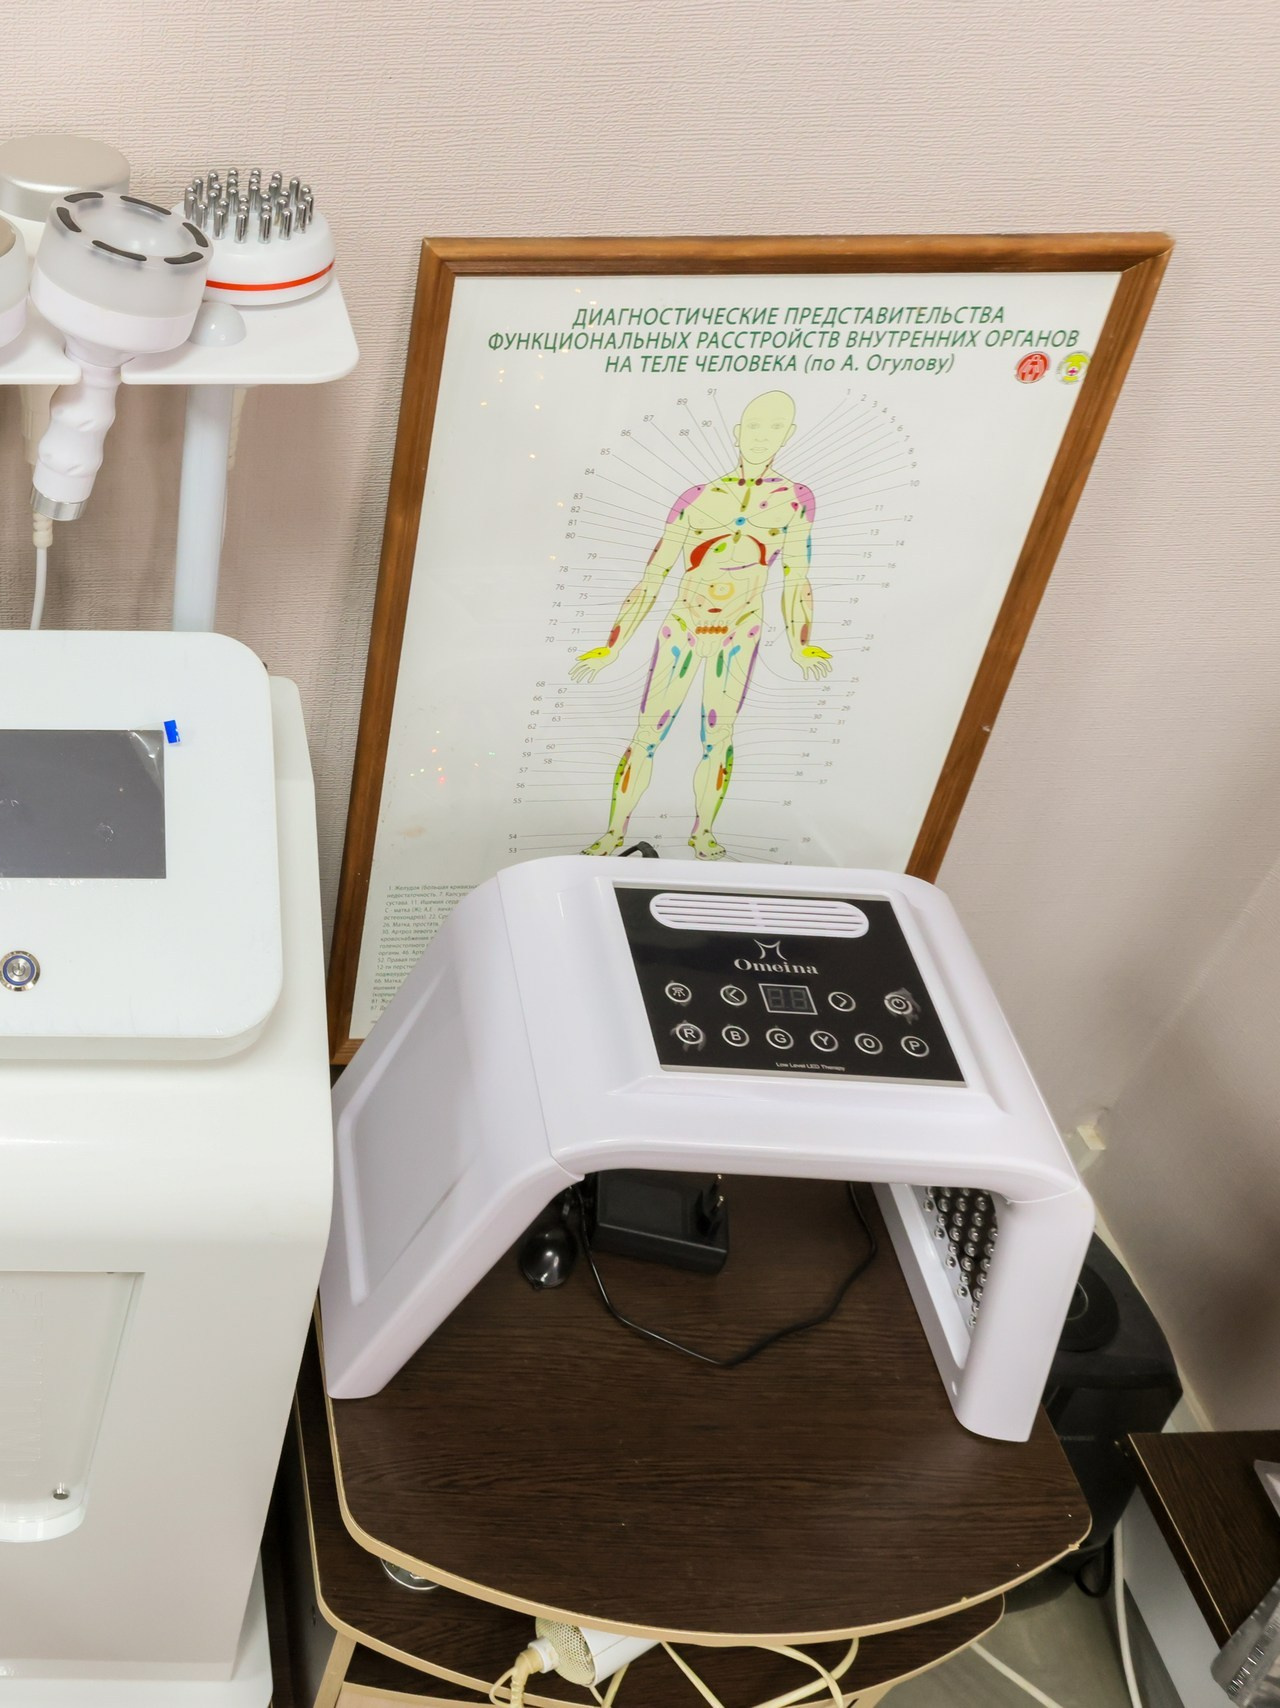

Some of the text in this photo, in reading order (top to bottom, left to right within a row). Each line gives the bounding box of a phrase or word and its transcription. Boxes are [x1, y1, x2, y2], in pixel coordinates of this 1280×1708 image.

[571, 305, 1005, 327] ДИАГНОСТИЧЕСКИЕ ПРЕДСТАВИТЕЛЬСТВА
[487, 327, 1080, 353] ФУНКЦИОНАЛЬНЫХ РАССТРОЙСТВ ВНУТРЕННИХ ОРГАНОВ
[604, 353, 955, 376] НА ТЕЛЕ ЧЕЛОВЕКА (по А. Огулову)
[733, 958, 819, 975] Omeina
[683, 1026, 697, 1039] R
[729, 1030, 742, 1041] B
[774, 1033, 788, 1044] G
[817, 1034, 830, 1046] Y
[862, 1037, 875, 1049] O
[907, 1040, 921, 1052] P
[789, 1062, 806, 1070] Level
[821, 1064, 846, 1072] Therapy
